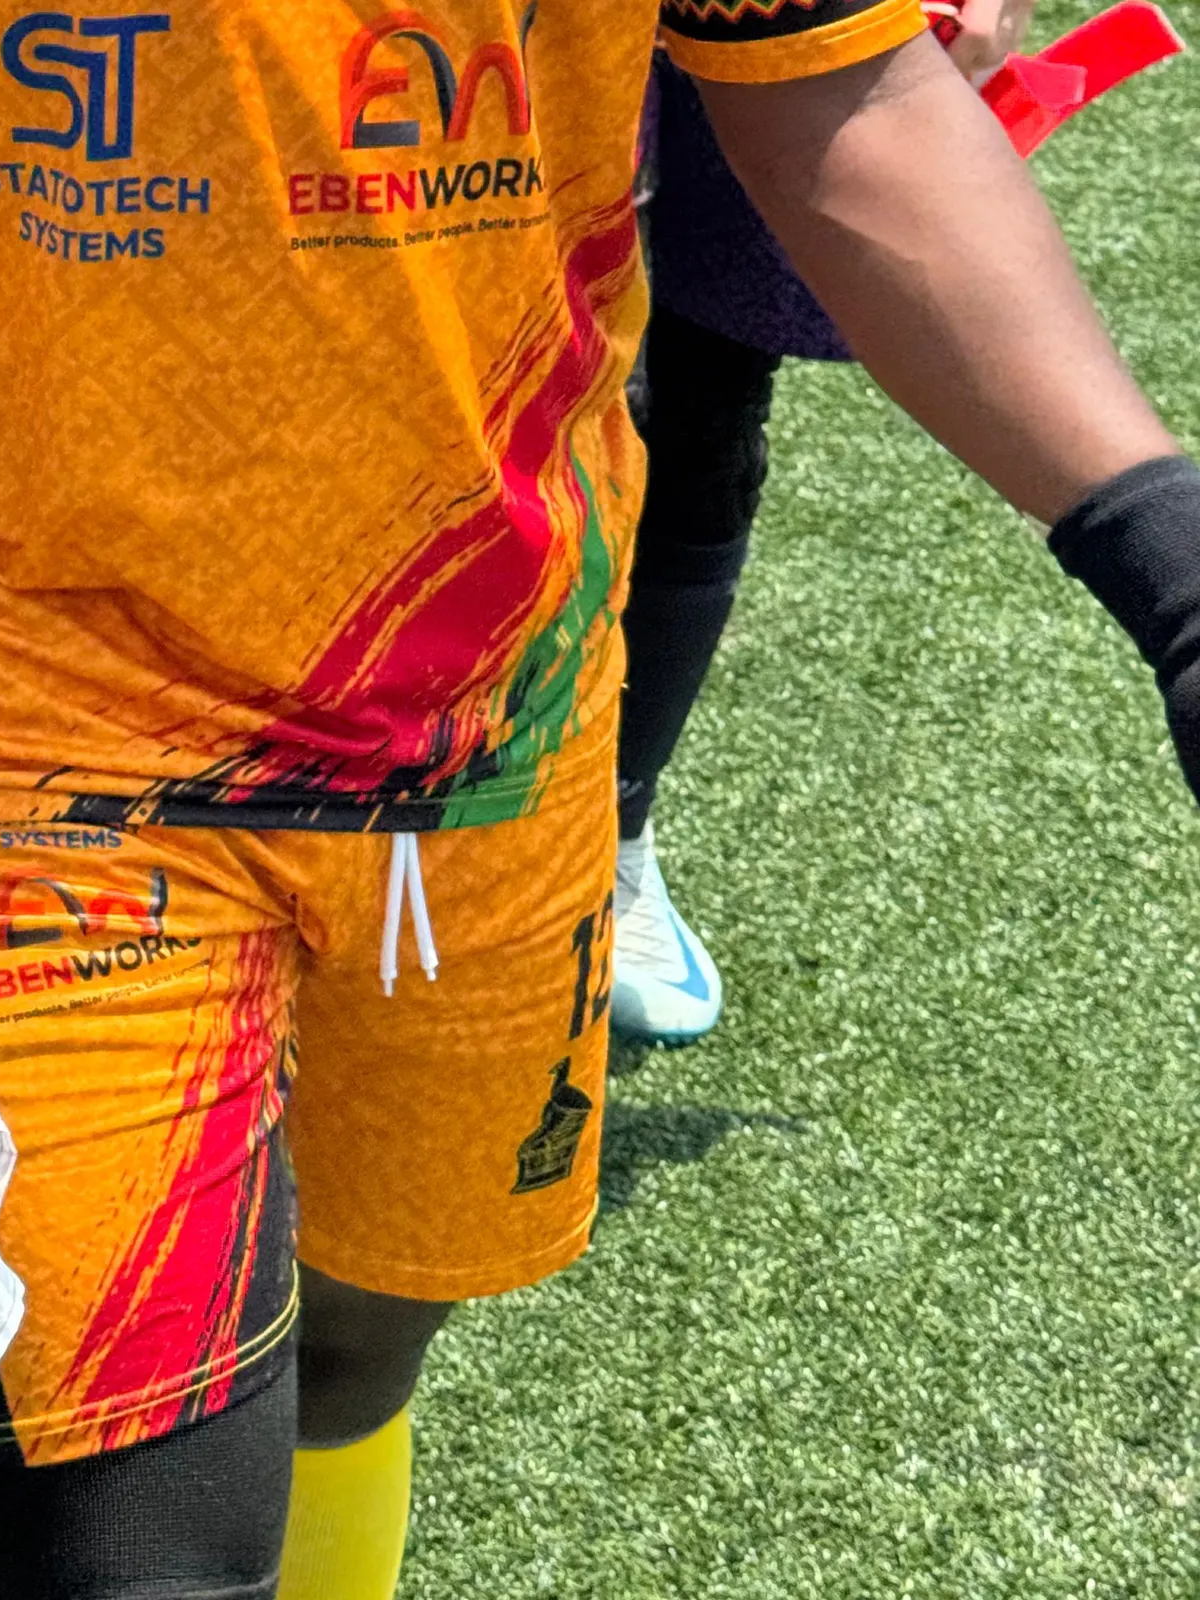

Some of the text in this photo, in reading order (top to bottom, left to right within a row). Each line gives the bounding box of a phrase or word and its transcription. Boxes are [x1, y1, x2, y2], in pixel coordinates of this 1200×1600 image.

[289, 157, 545, 216] EBENWORK
[19, 211, 165, 262] SYSTEMS
[290, 236, 331, 251] Better
[478, 217, 515, 231] Better
[0, 829, 122, 849] SYSTEMS
